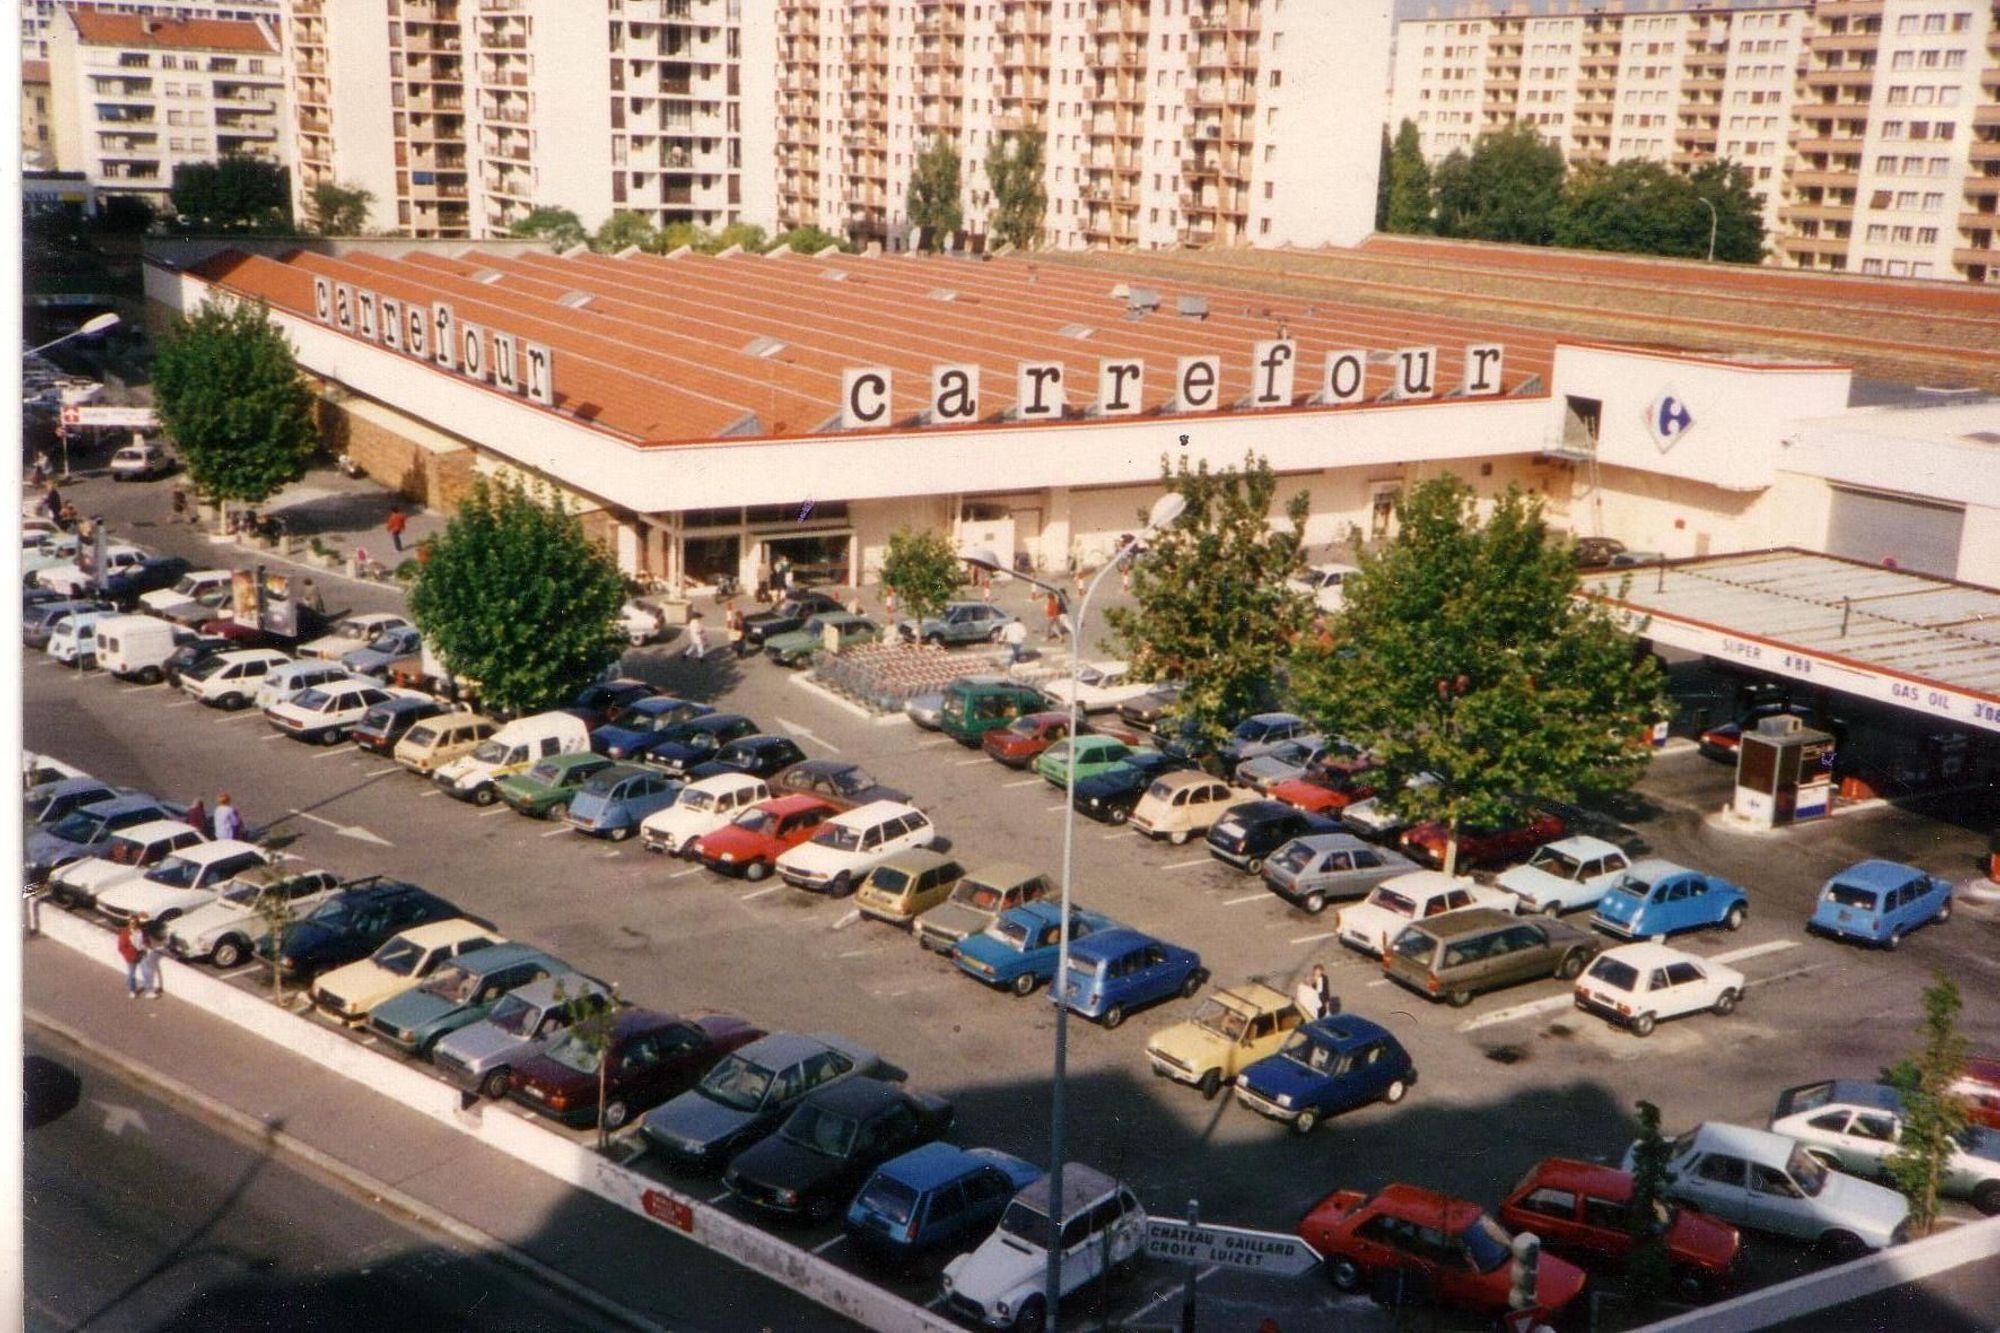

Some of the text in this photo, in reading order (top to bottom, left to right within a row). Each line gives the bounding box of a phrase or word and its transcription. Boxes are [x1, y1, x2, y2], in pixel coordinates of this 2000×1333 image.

[317, 281, 545, 397] carrefour
[850, 346, 1500, 422] carrefour
[1892, 683, 1919, 701] GAS
[1928, 692, 1950, 709] OIL
[1150, 1240, 1263, 1266] CROIX LUIZET
[1225, 1236, 1295, 1256] GAILLARD
